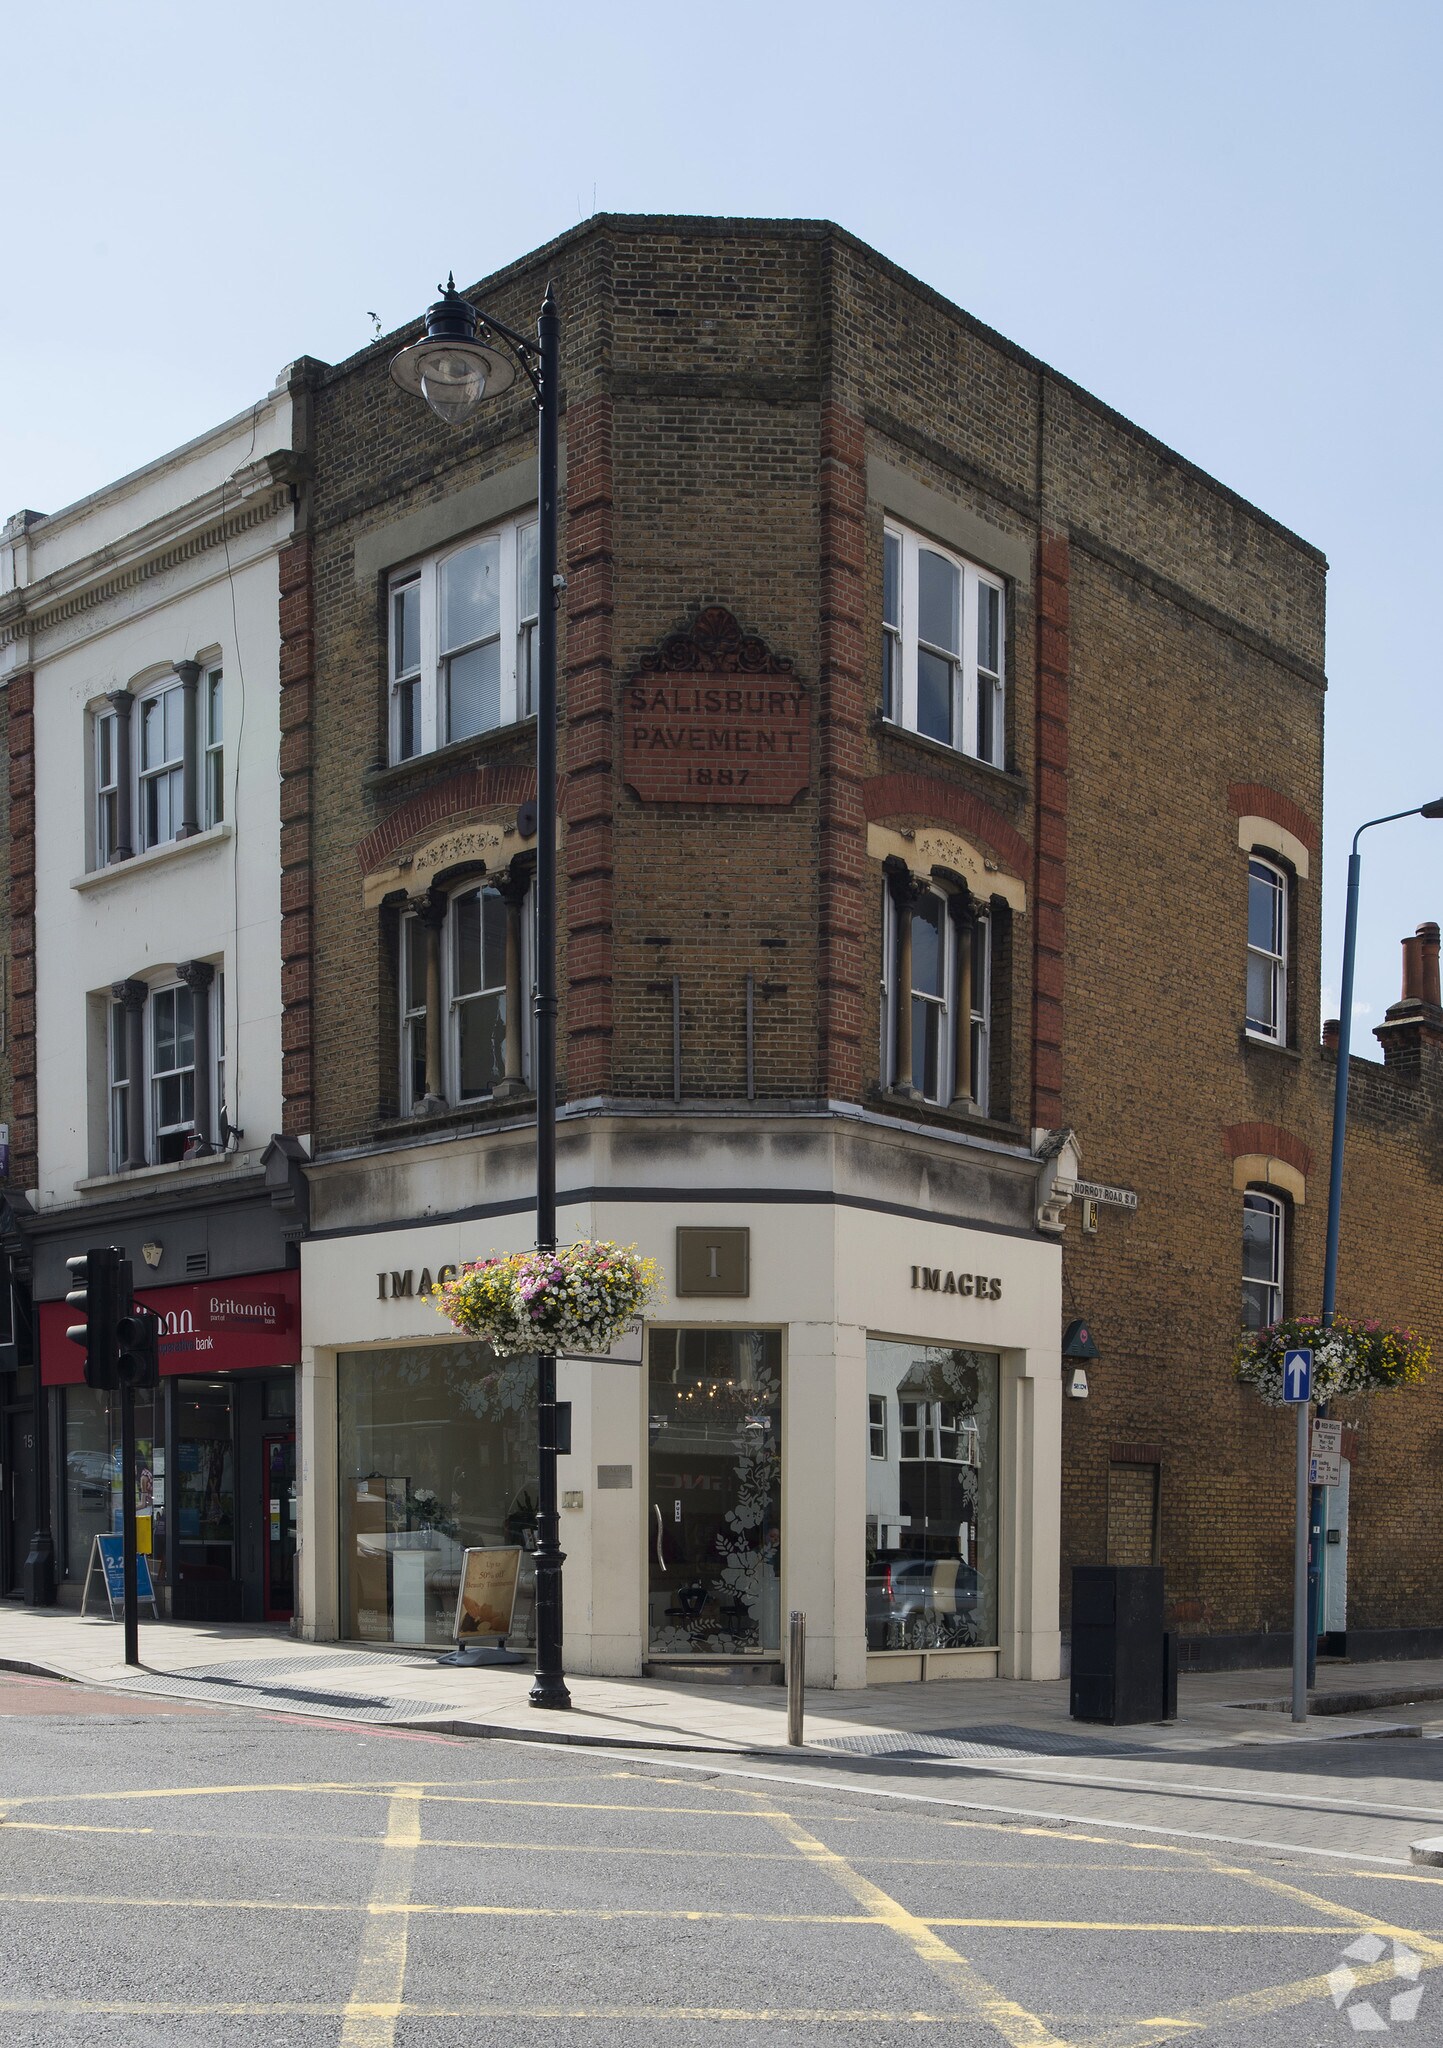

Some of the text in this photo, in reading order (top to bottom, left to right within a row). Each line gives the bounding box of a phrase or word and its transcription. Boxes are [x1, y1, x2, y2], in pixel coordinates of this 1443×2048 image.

[630, 688, 801, 718] SALISBURY
[632, 727, 801, 752] PAVEMENT
[687, 768, 749, 786] 1887
[911, 1266, 1002, 1300] IMAGES
[209, 1297, 276, 1317] Britannia
[195, 1335, 214, 1351] bank
